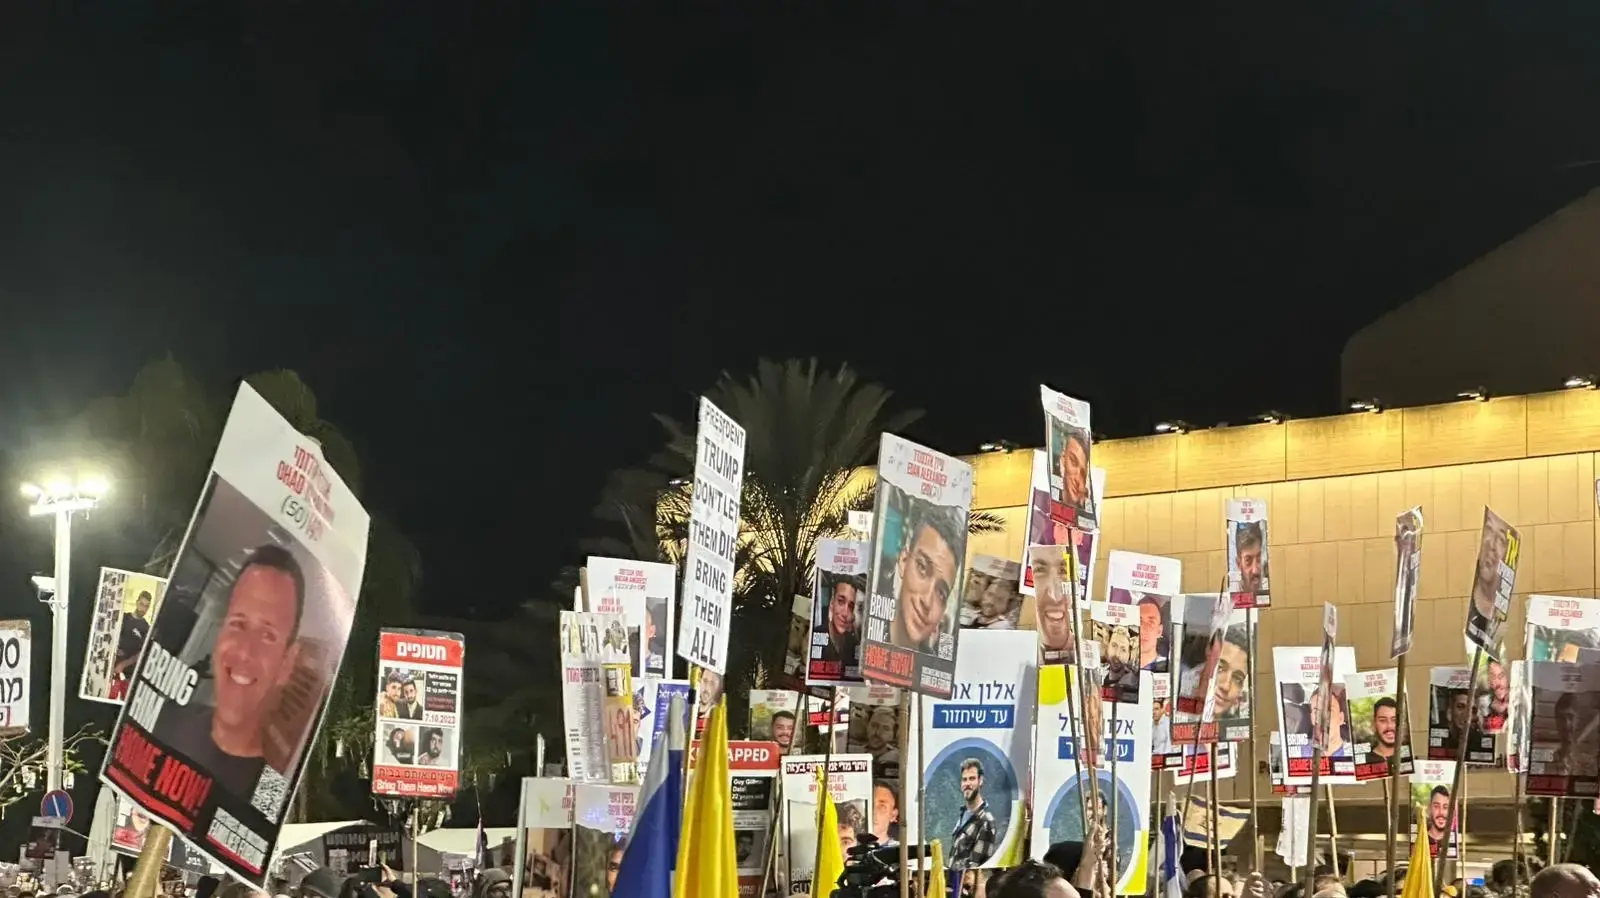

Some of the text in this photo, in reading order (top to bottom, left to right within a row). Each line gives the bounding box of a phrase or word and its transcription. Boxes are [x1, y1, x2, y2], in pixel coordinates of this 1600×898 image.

[705, 404, 744, 448] PRESIDENT
[276, 460, 306, 494] OHAD
[695, 478, 739, 524] DON'T LET
[692, 519, 736, 563] THEM DIE
[695, 558, 726, 595] BRING
[694, 594, 722, 629] THEM
[869, 594, 896, 622] BRING
[690, 626, 717, 667] ALL
[867, 616, 885, 643] HIM
[396, 641, 447, 661] חטופים
[142, 639, 199, 707] BRING
[128, 680, 165, 734] HIM
[978, 680, 1015, 704] אלון
[424, 713, 456, 725] 7.10.2023
[941, 709, 1008, 725] עד שיחזור
[116, 723, 214, 817] HOME NOW!
[689, 747, 770, 762] KIAPPED
[376, 779, 396, 791] Bring
[397, 780, 416, 791] Them
[417, 781, 437, 793] Home
